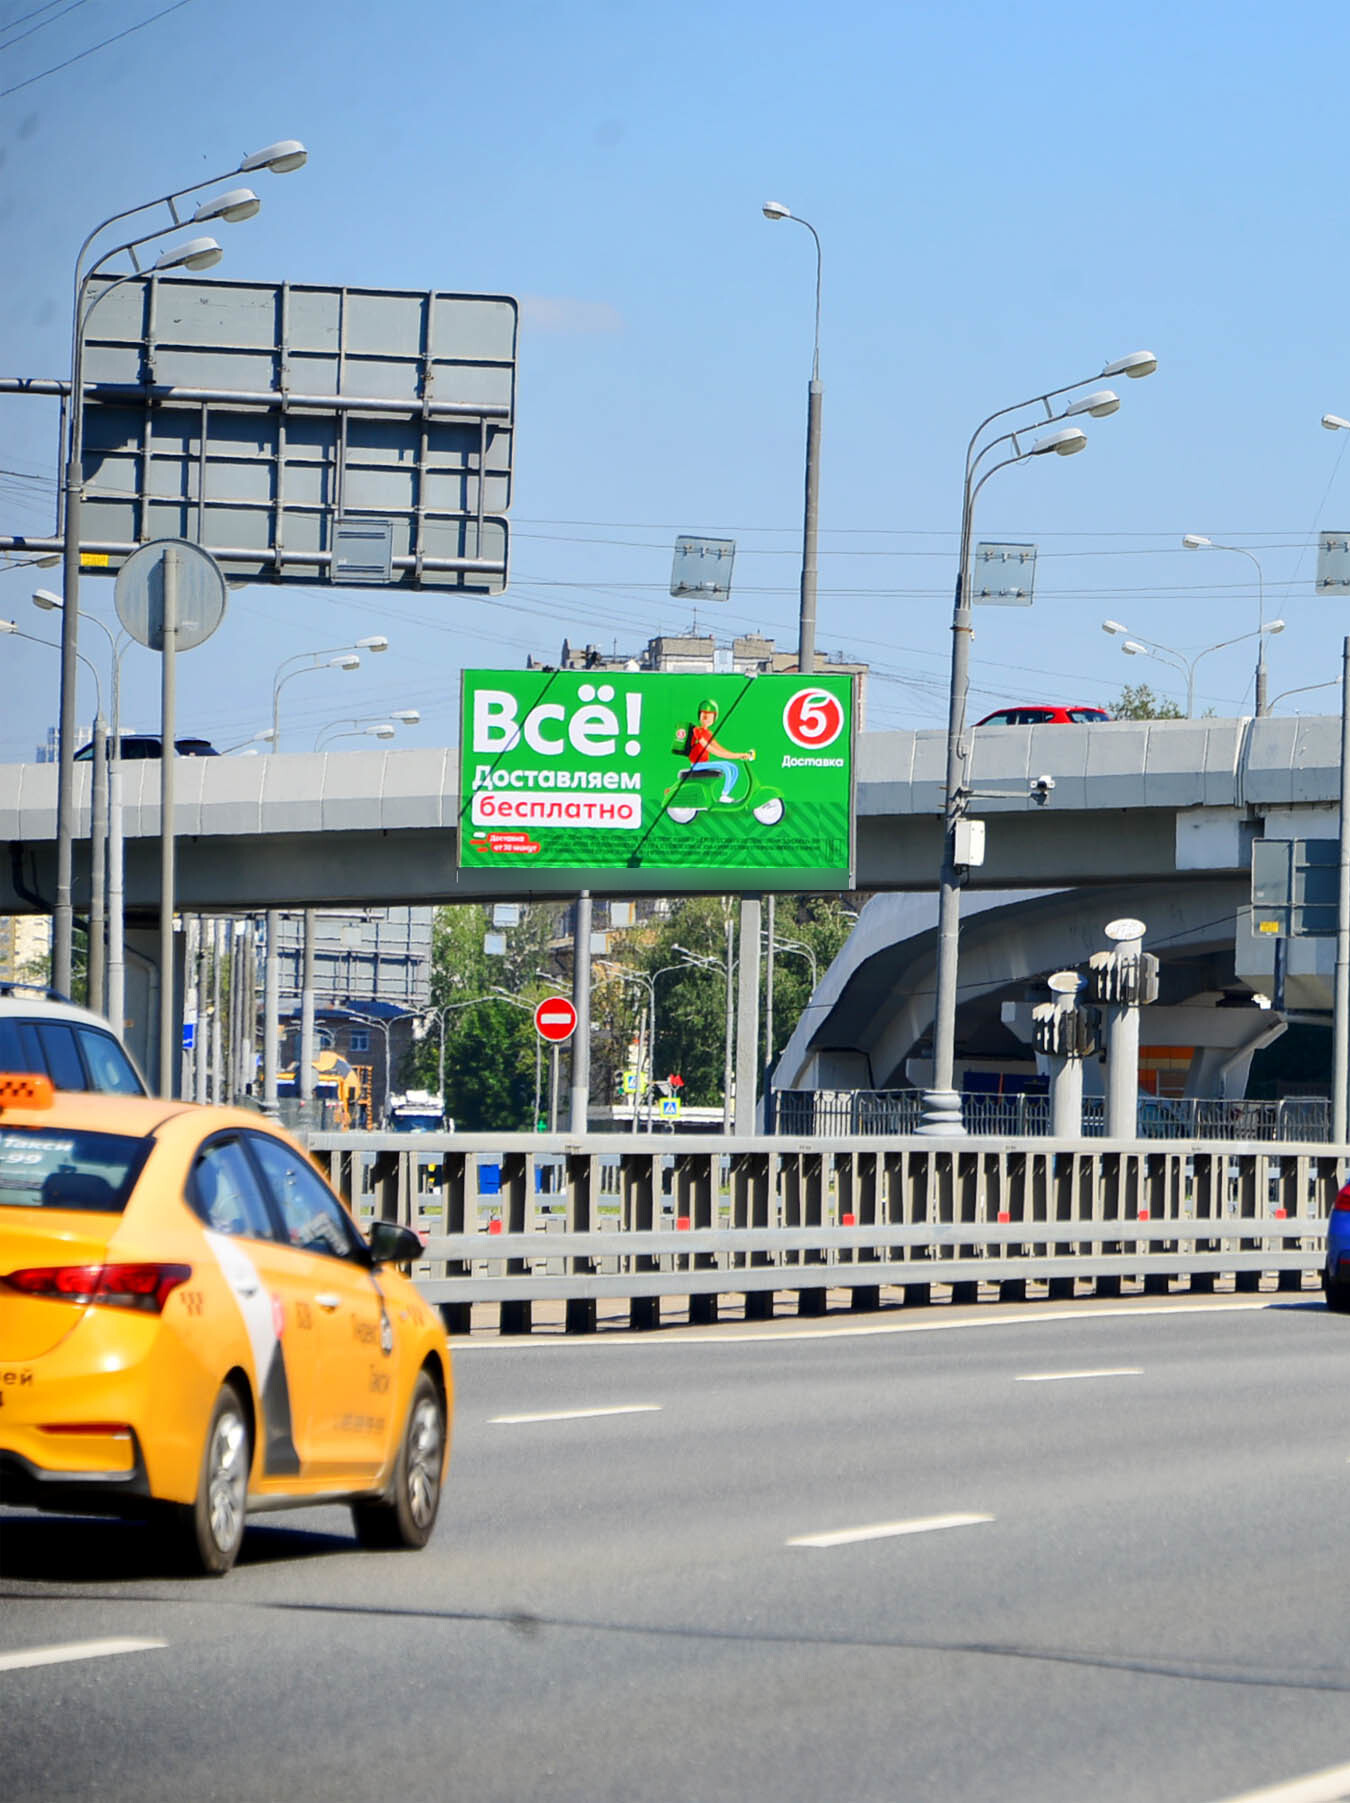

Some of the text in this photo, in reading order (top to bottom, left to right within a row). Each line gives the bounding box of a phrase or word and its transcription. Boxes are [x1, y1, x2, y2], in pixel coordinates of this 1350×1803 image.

[473, 684, 642, 757] Всё!
[798, 692, 832, 738] 5
[781, 755, 844, 768] Доставка
[472, 765, 641, 791] Доставляем
[480, 795, 634, 822] бесплатно
